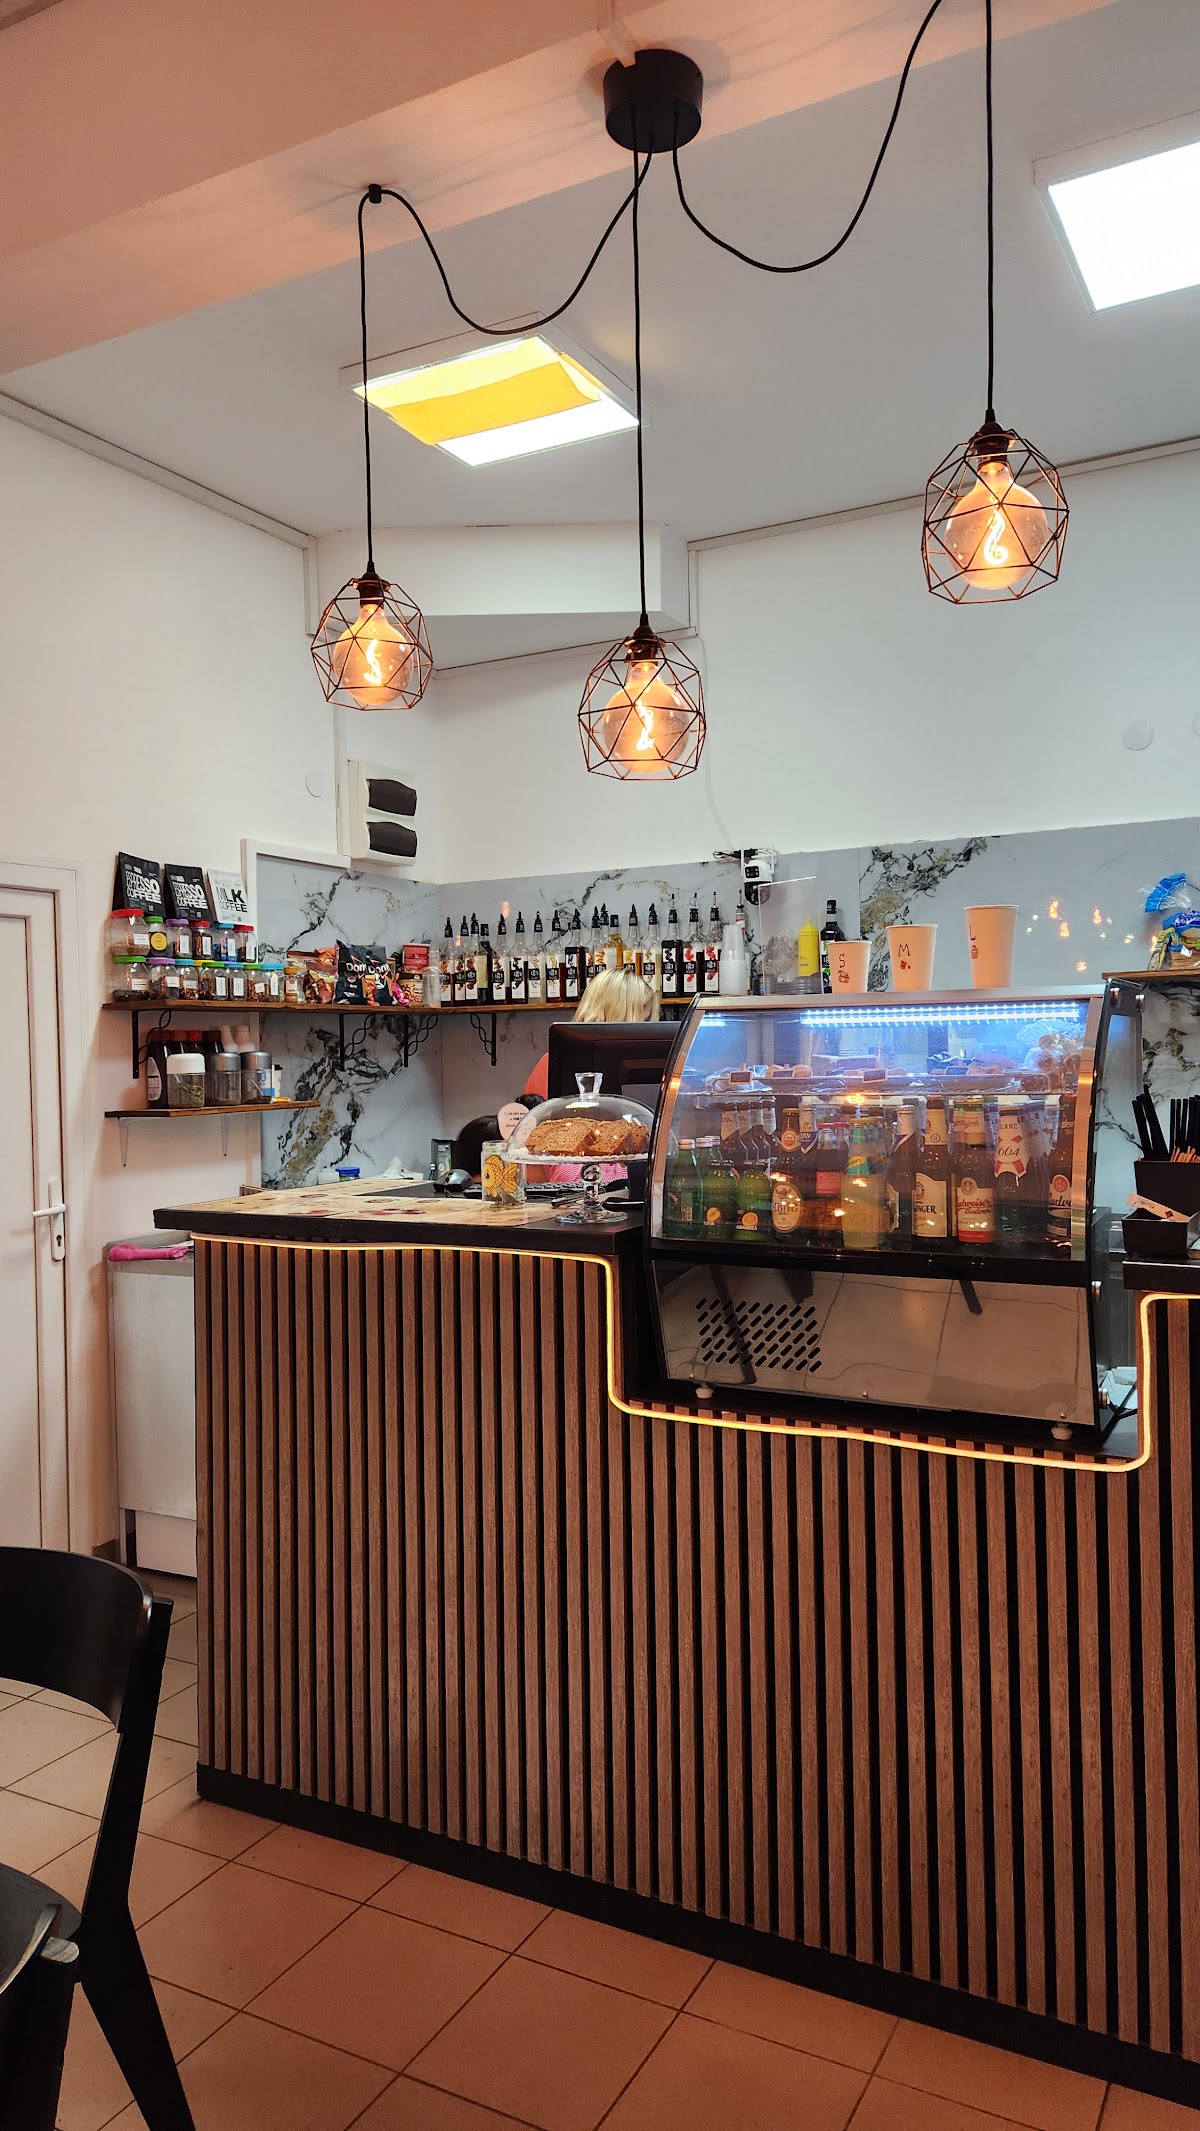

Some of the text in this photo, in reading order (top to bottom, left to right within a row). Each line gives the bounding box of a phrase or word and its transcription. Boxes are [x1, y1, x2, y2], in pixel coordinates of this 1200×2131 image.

[127, 887, 162, 904] COFFEE
[216, 886, 245, 904] MILK
[177, 897, 208, 910] COFFEE
[219, 900, 248, 913] COFFEE
[969, 924, 977, 941] L
[898, 943, 911, 957] M
[838, 953, 846, 969] S
